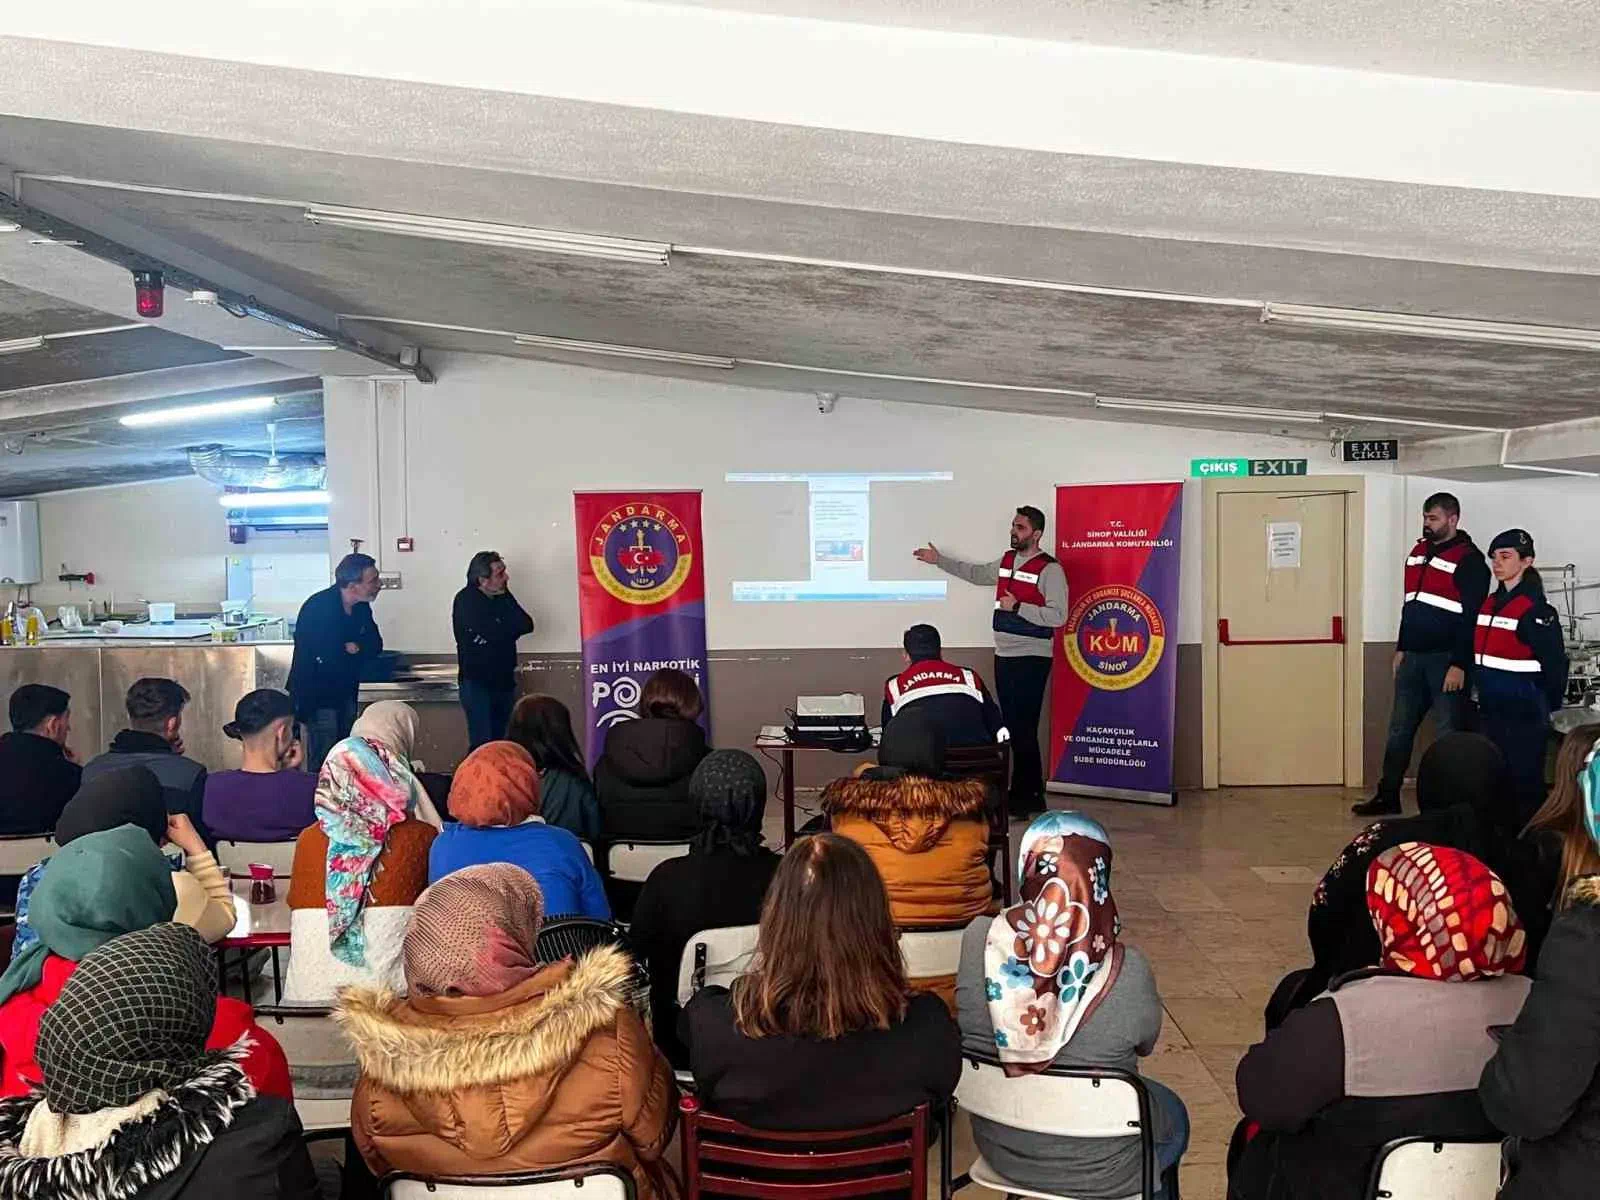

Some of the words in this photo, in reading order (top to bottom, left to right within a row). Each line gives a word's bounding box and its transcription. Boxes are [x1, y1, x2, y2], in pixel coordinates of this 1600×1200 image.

[1351, 442, 1390, 451] EXIT
[1199, 462, 1238, 475] ÇIKIŞ
[1254, 461, 1303, 474] EXIT
[595, 505, 686, 545] JANDARMA
[1110, 520, 1125, 528] T.C.
[1113, 529, 1147, 537] VALİLİĞİ
[1116, 539, 1173, 548] KOMUTANLIĞI
[1088, 602, 1141, 622] JANDARMA
[1090, 635, 1138, 653] KOM
[590, 663, 608, 674] EN
[612, 660, 630, 672] İYİ
[633, 658, 700, 672] NARKOTİK
[1098, 660, 1127, 672] SİNOP
[904, 672, 960, 690] JANDARMA
[1086, 727, 1135, 735] KAÇAKÇILIK
[1075, 735, 1115, 745] ORGANİZE
[1088, 746, 1131, 756] MÜCADELE
[1096, 757, 1146, 767] MÜDÜRLÜĞÜ
